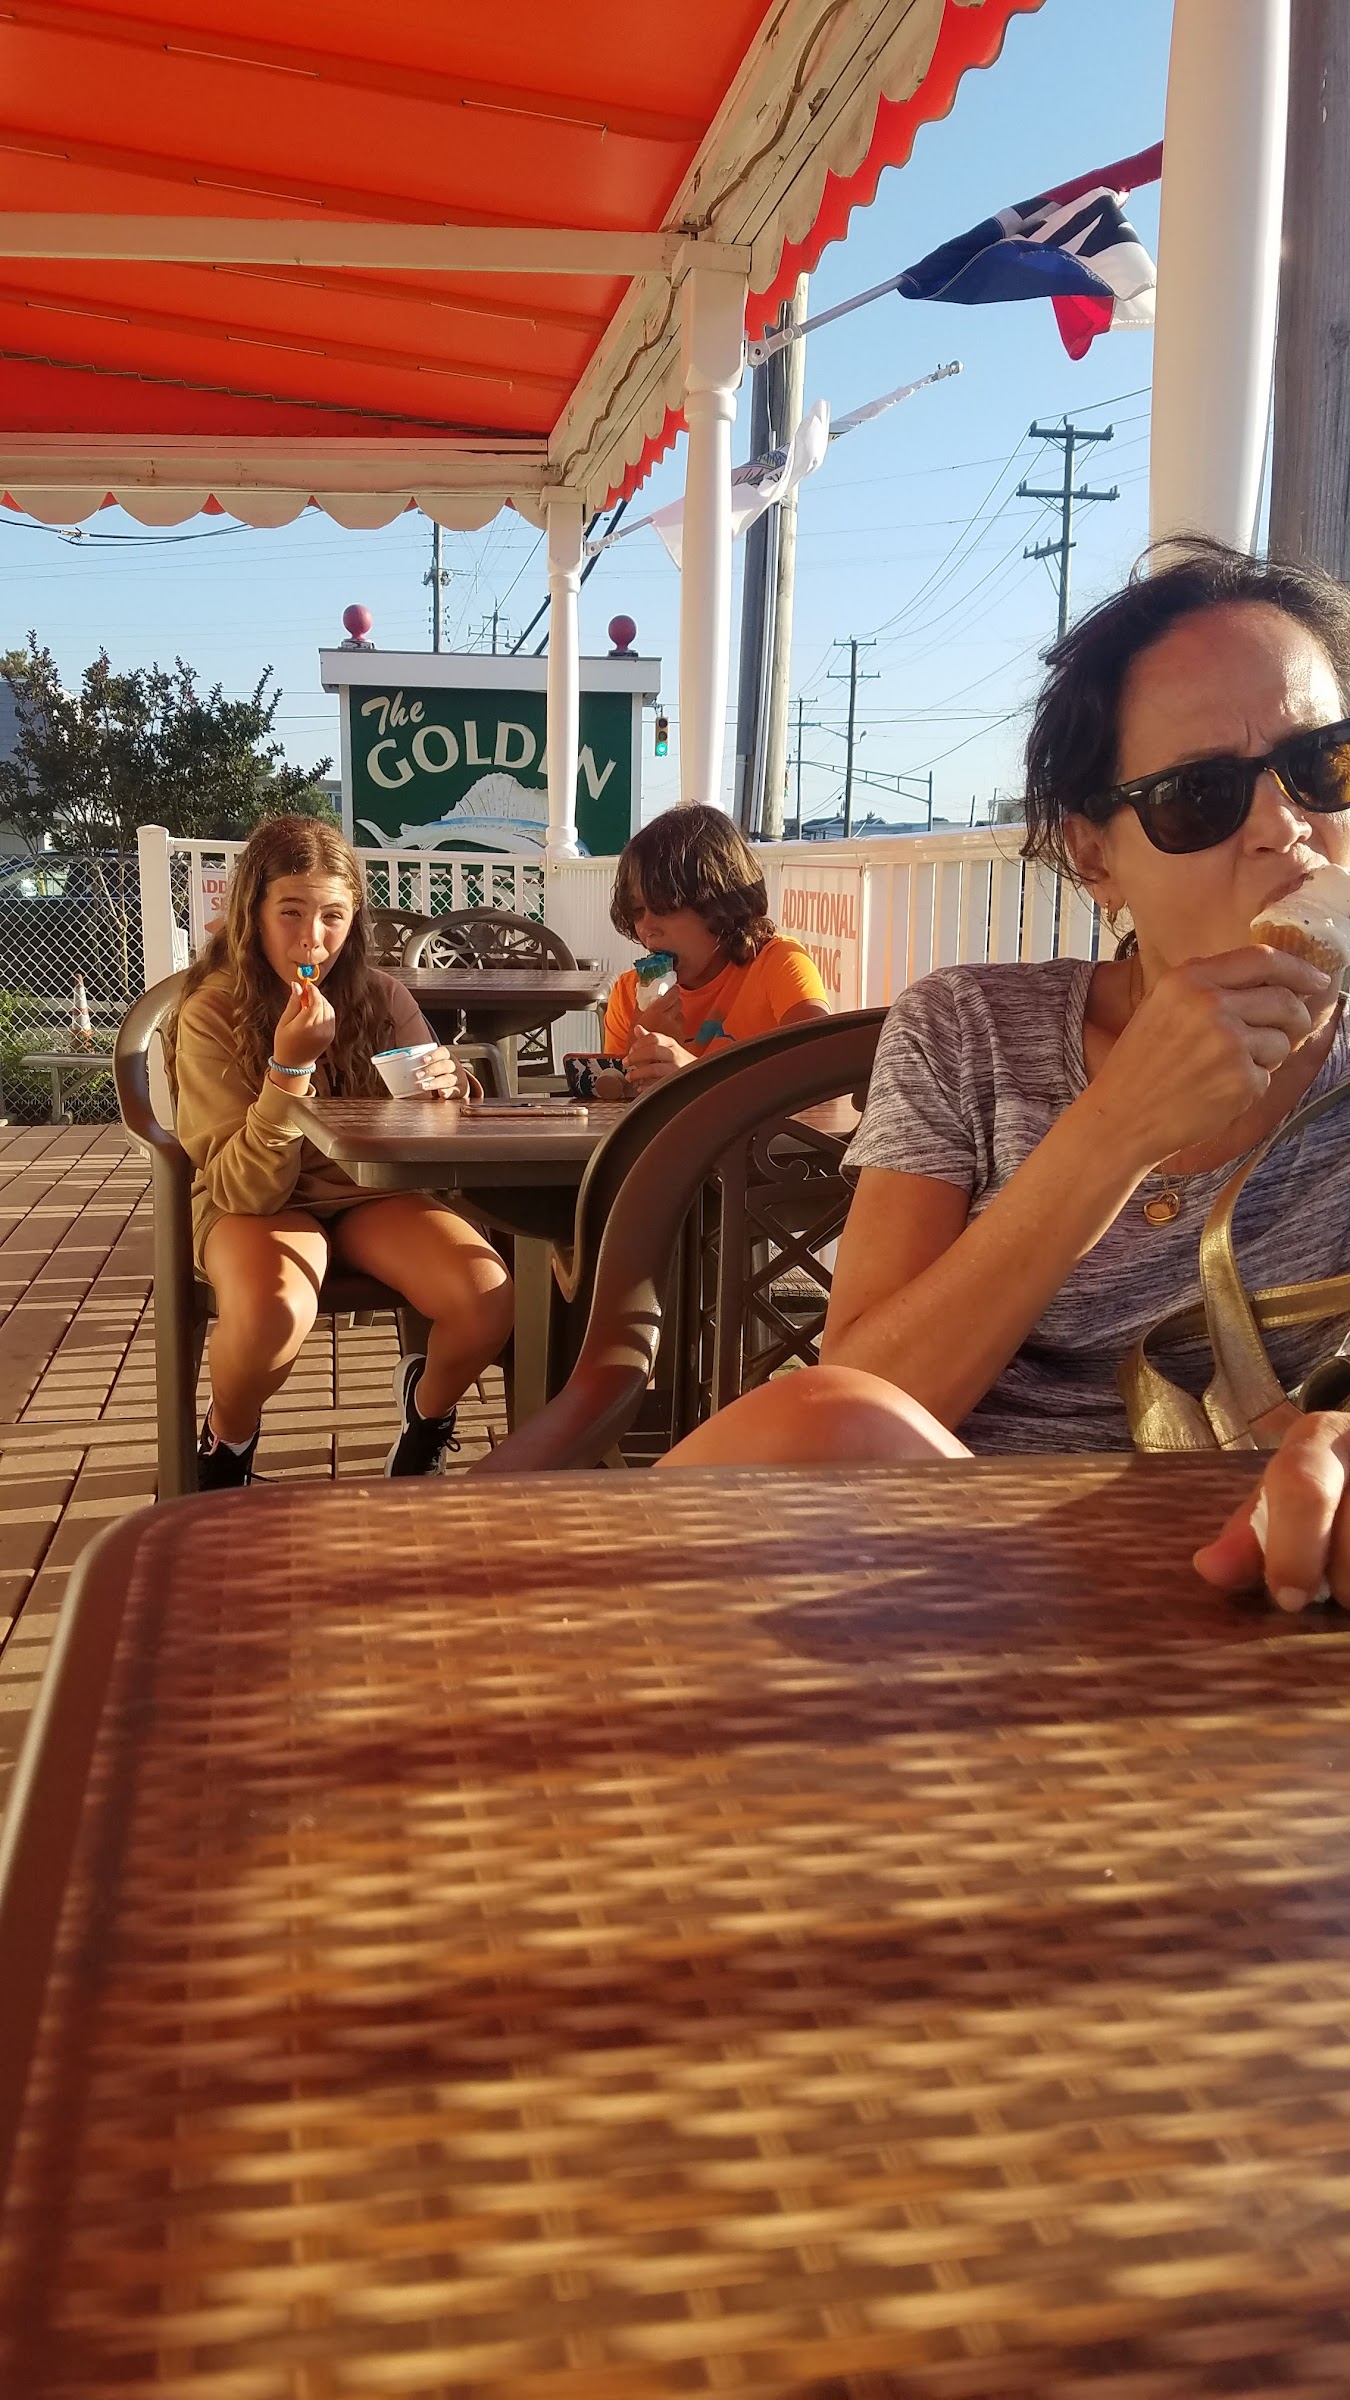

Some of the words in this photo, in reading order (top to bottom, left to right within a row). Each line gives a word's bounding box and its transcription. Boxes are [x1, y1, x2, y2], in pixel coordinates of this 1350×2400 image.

[361, 690, 426, 736] The
[367, 720, 617, 801] GOLDN
[781, 888, 857, 940] ADDITIONAL
[804, 943, 842, 993] TING
